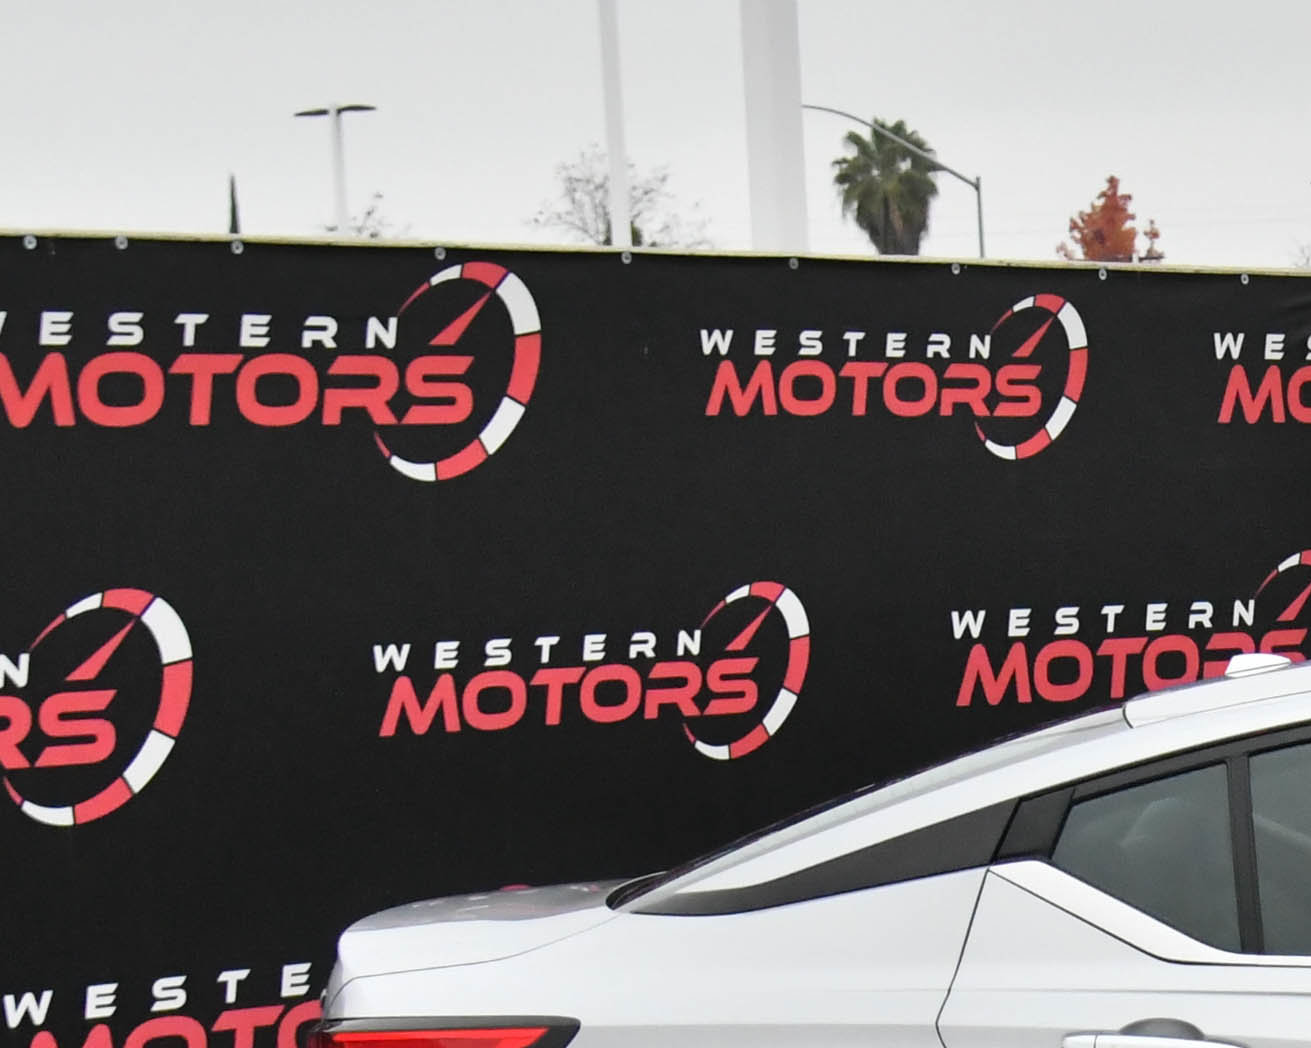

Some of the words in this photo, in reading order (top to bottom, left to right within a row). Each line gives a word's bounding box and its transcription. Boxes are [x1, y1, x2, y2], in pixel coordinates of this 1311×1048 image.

[0, 311, 398, 349] ESTERN
[700, 328, 991, 360] WESTERN
[0, 351, 474, 429] MOTORS
[705, 359, 1042, 417] MOTORS
[950, 599, 1255, 640] WESTERN
[372, 629, 702, 673] WESTERN
[379, 657, 759, 737] MOTORS
[2, 962, 327, 1029] WESTE
